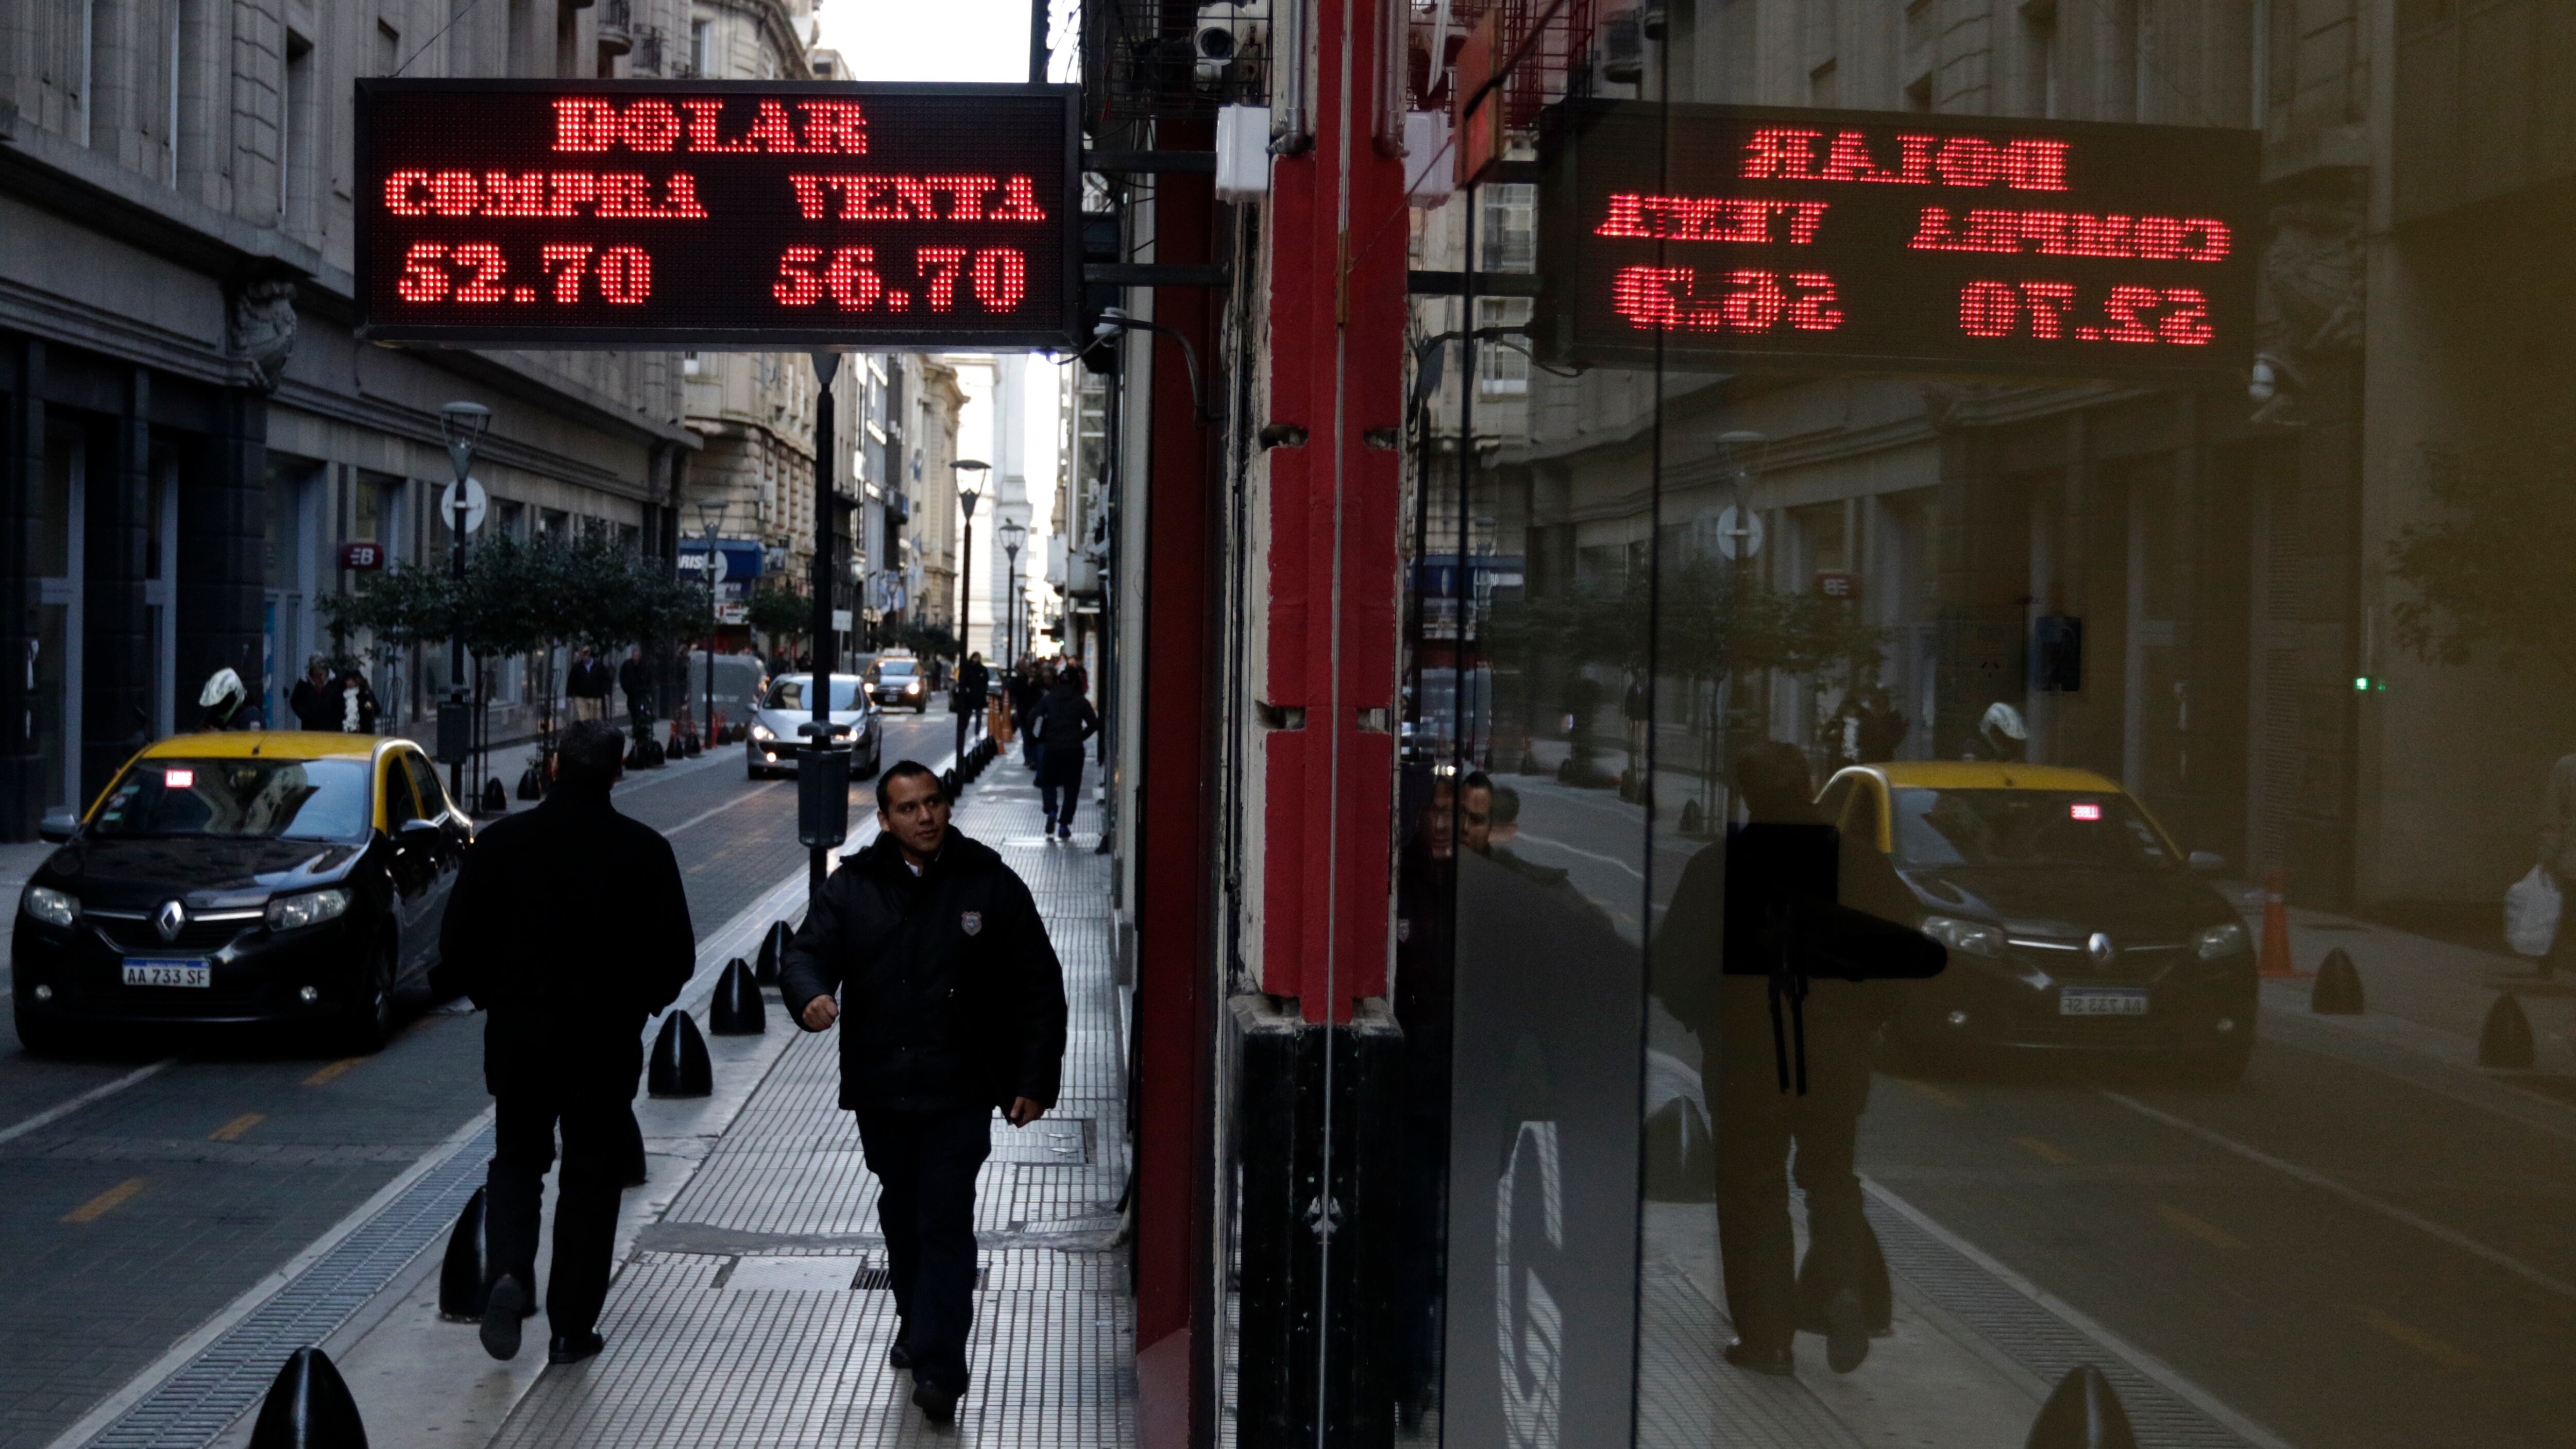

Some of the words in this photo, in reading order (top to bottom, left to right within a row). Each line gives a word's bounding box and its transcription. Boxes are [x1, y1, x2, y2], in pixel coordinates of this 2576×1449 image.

[550, 96, 869, 156] DOLAR
[384, 168, 709, 219] COMPRA
[788, 173, 1047, 222] VENTA
[398, 240, 652, 304] 52.70
[772, 244, 1025, 313] 56.70
[129, 968, 146, 983] AA
[153, 969, 180, 984] 733
[188, 970, 206, 984] SF
